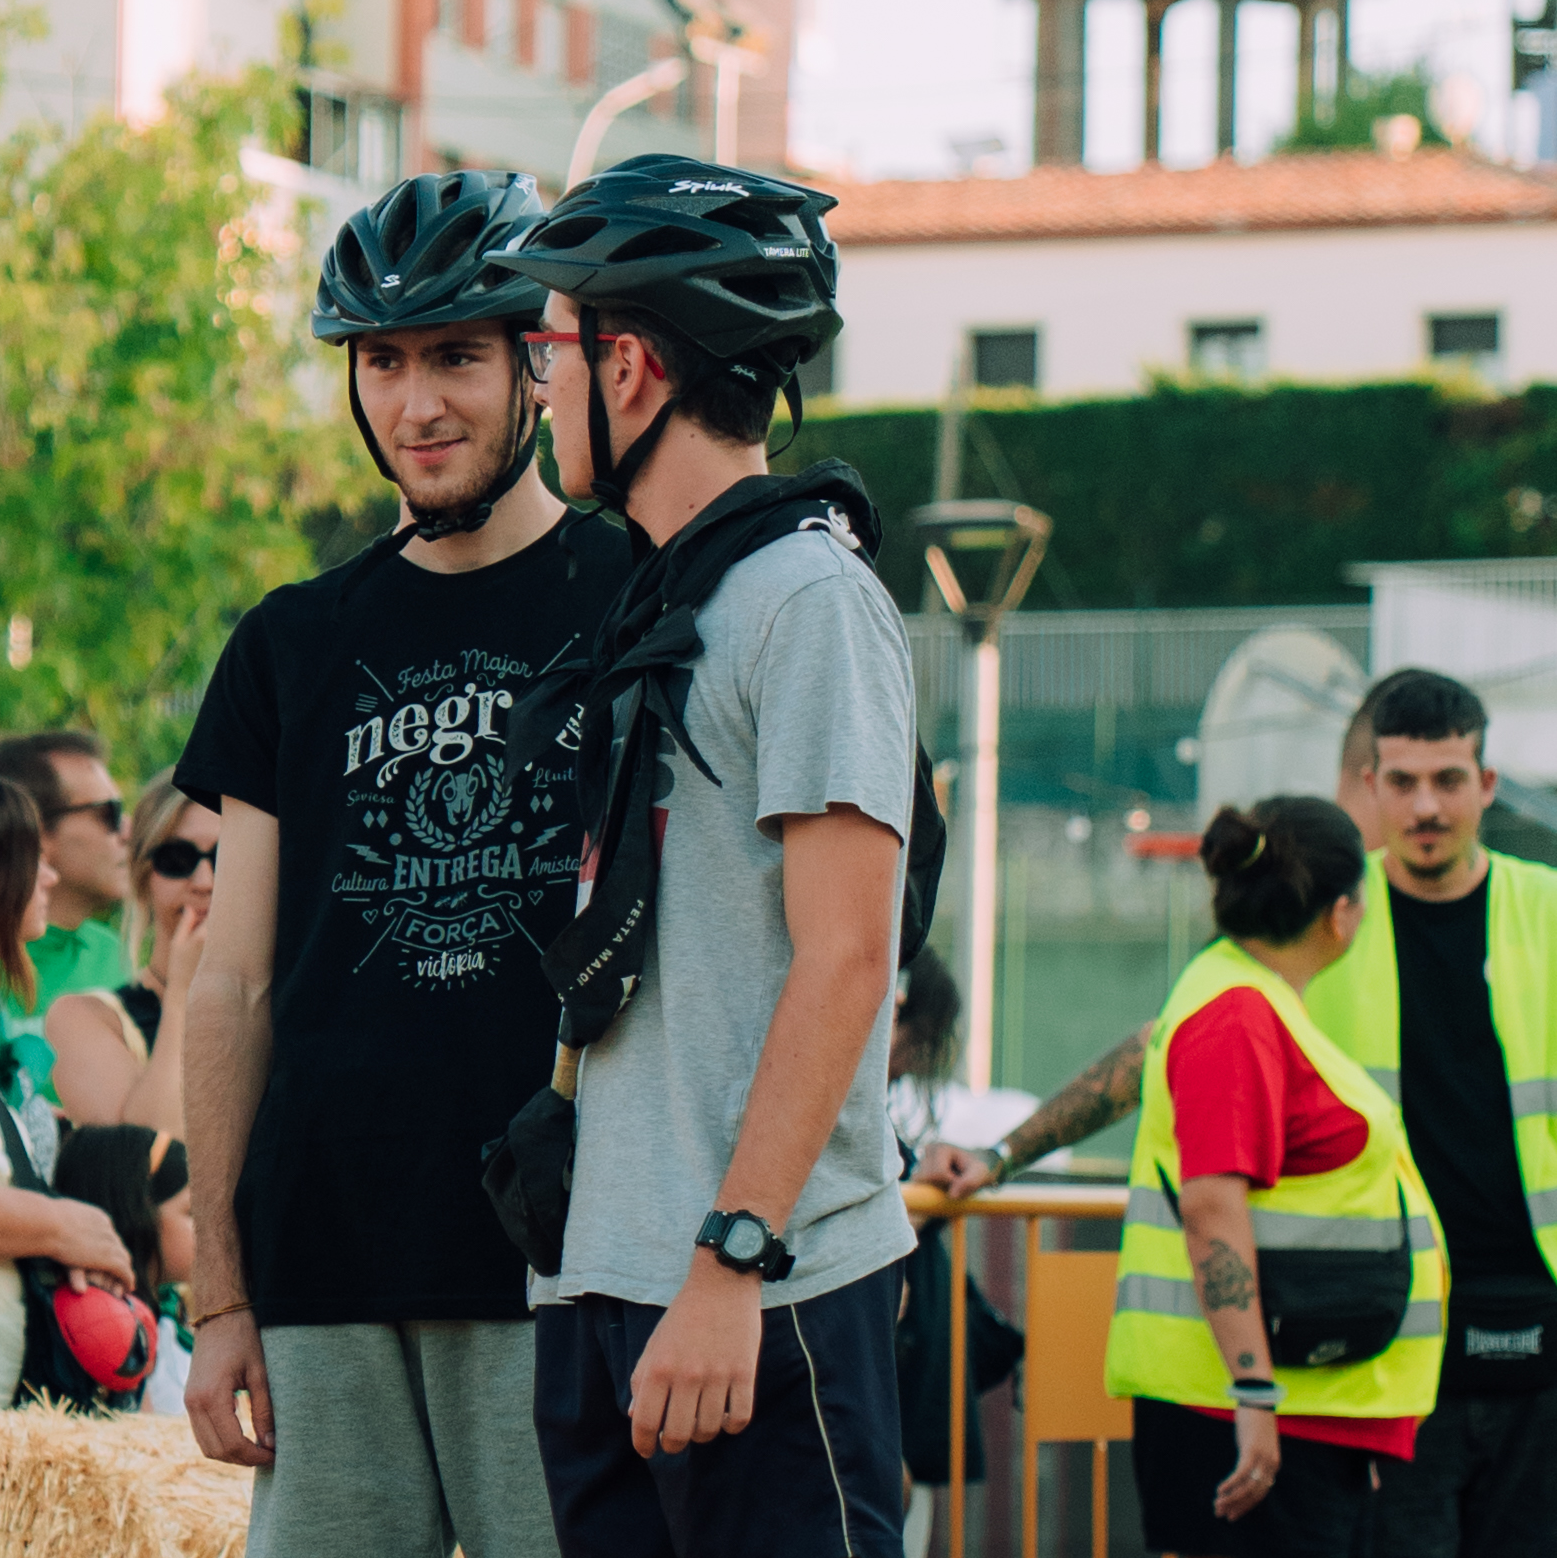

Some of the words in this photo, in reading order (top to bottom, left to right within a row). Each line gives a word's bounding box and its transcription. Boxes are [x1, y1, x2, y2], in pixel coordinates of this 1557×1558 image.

[397, 659, 456, 694] Festa
[460, 648, 533, 679] Major
[343, 683, 513, 777] negr
[532, 767, 577, 789] Lluit
[331, 871, 389, 892] Cultura
[392, 843, 523, 890] ENTREGA
[528, 856, 581, 877] Amista
[405, 912, 501, 946] FORÇA
[612, 899, 644, 943] FESTA
